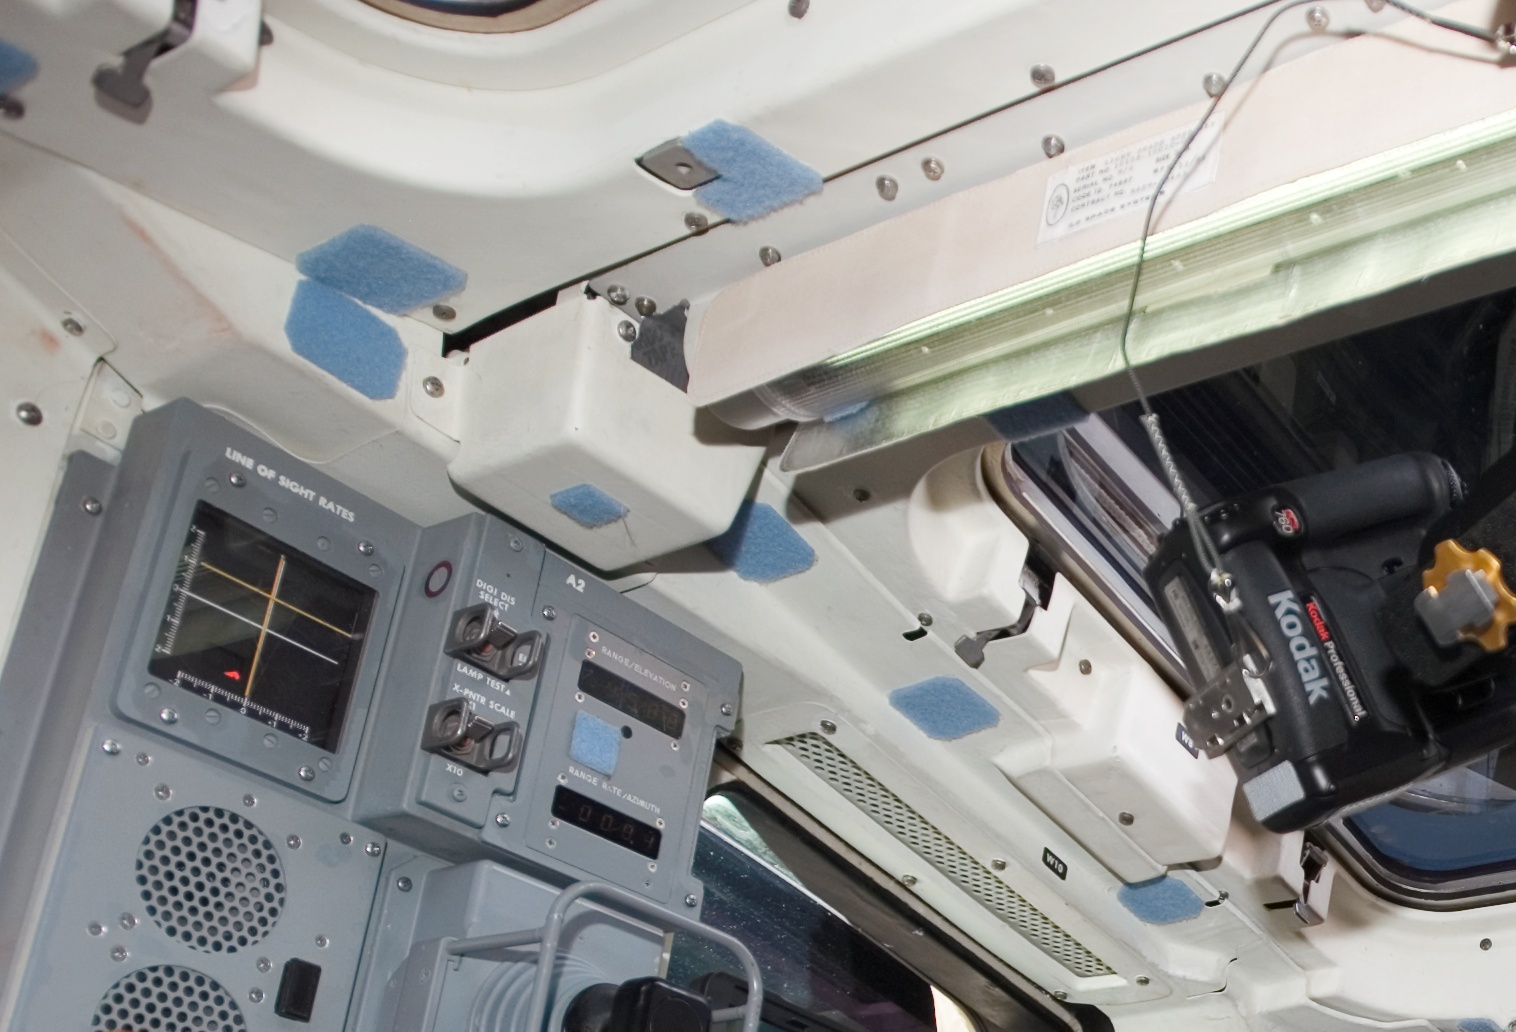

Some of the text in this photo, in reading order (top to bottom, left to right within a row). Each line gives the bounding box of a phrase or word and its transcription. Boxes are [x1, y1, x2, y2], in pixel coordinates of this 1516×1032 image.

[225, 447, 355, 523] LINE OF SIGHT RATES
[1274, 509, 1295, 534] 760
[475, 579, 516, 605] DIGI DIS
[565, 573, 586, 594] A2
[479, 591, 509, 611] SELECT
[1267, 589, 1329, 707] Kodak
[1306, 601, 1367, 718] Kodak Professional
[456, 663, 506, 695] LAMP TEST
[601, 646, 677, 692] RANGE/ELEVATION
[452, 683, 516, 719] X-PNTR SCALE
[445, 763, 464, 777] X10
[568, 766, 598, 786] RANGE
